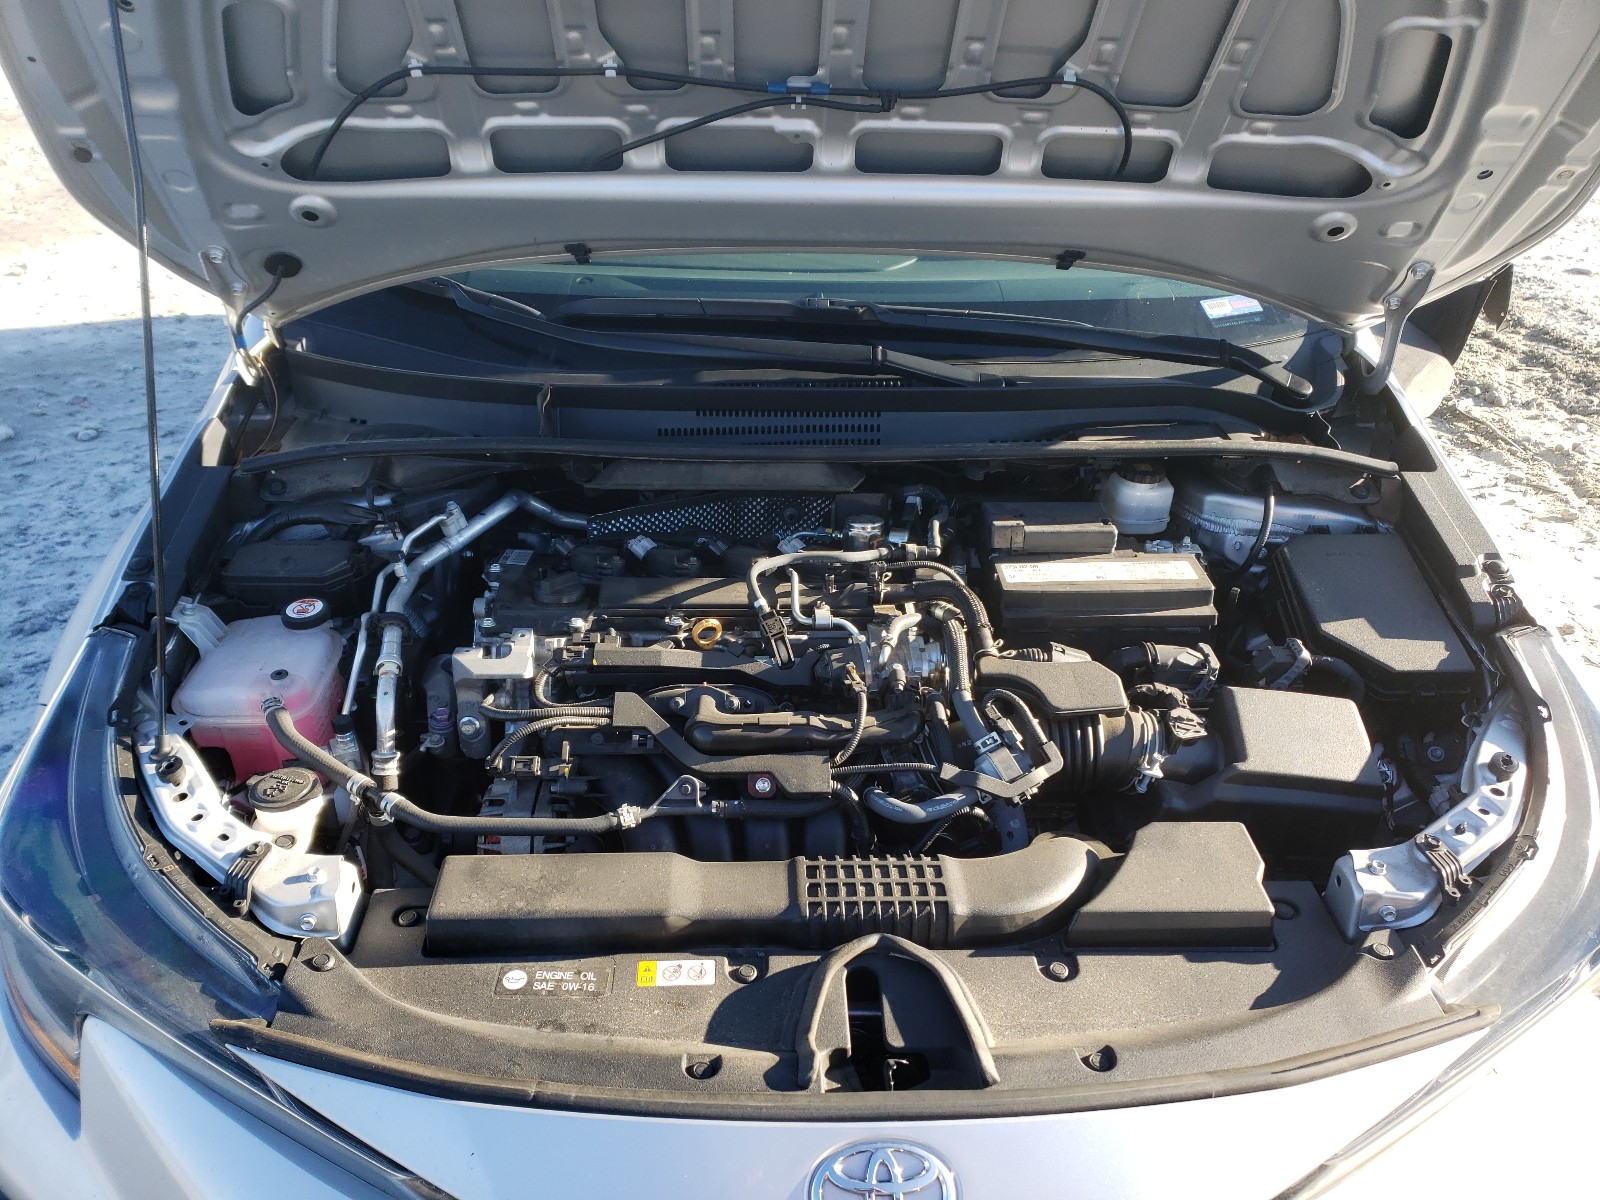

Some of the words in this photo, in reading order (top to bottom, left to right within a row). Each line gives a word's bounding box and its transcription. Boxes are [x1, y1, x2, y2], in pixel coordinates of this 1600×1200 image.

[535, 971, 574, 980] ENGINE
[580, 971, 597, 981] OIL
[532, 981, 555, 990] SAE
